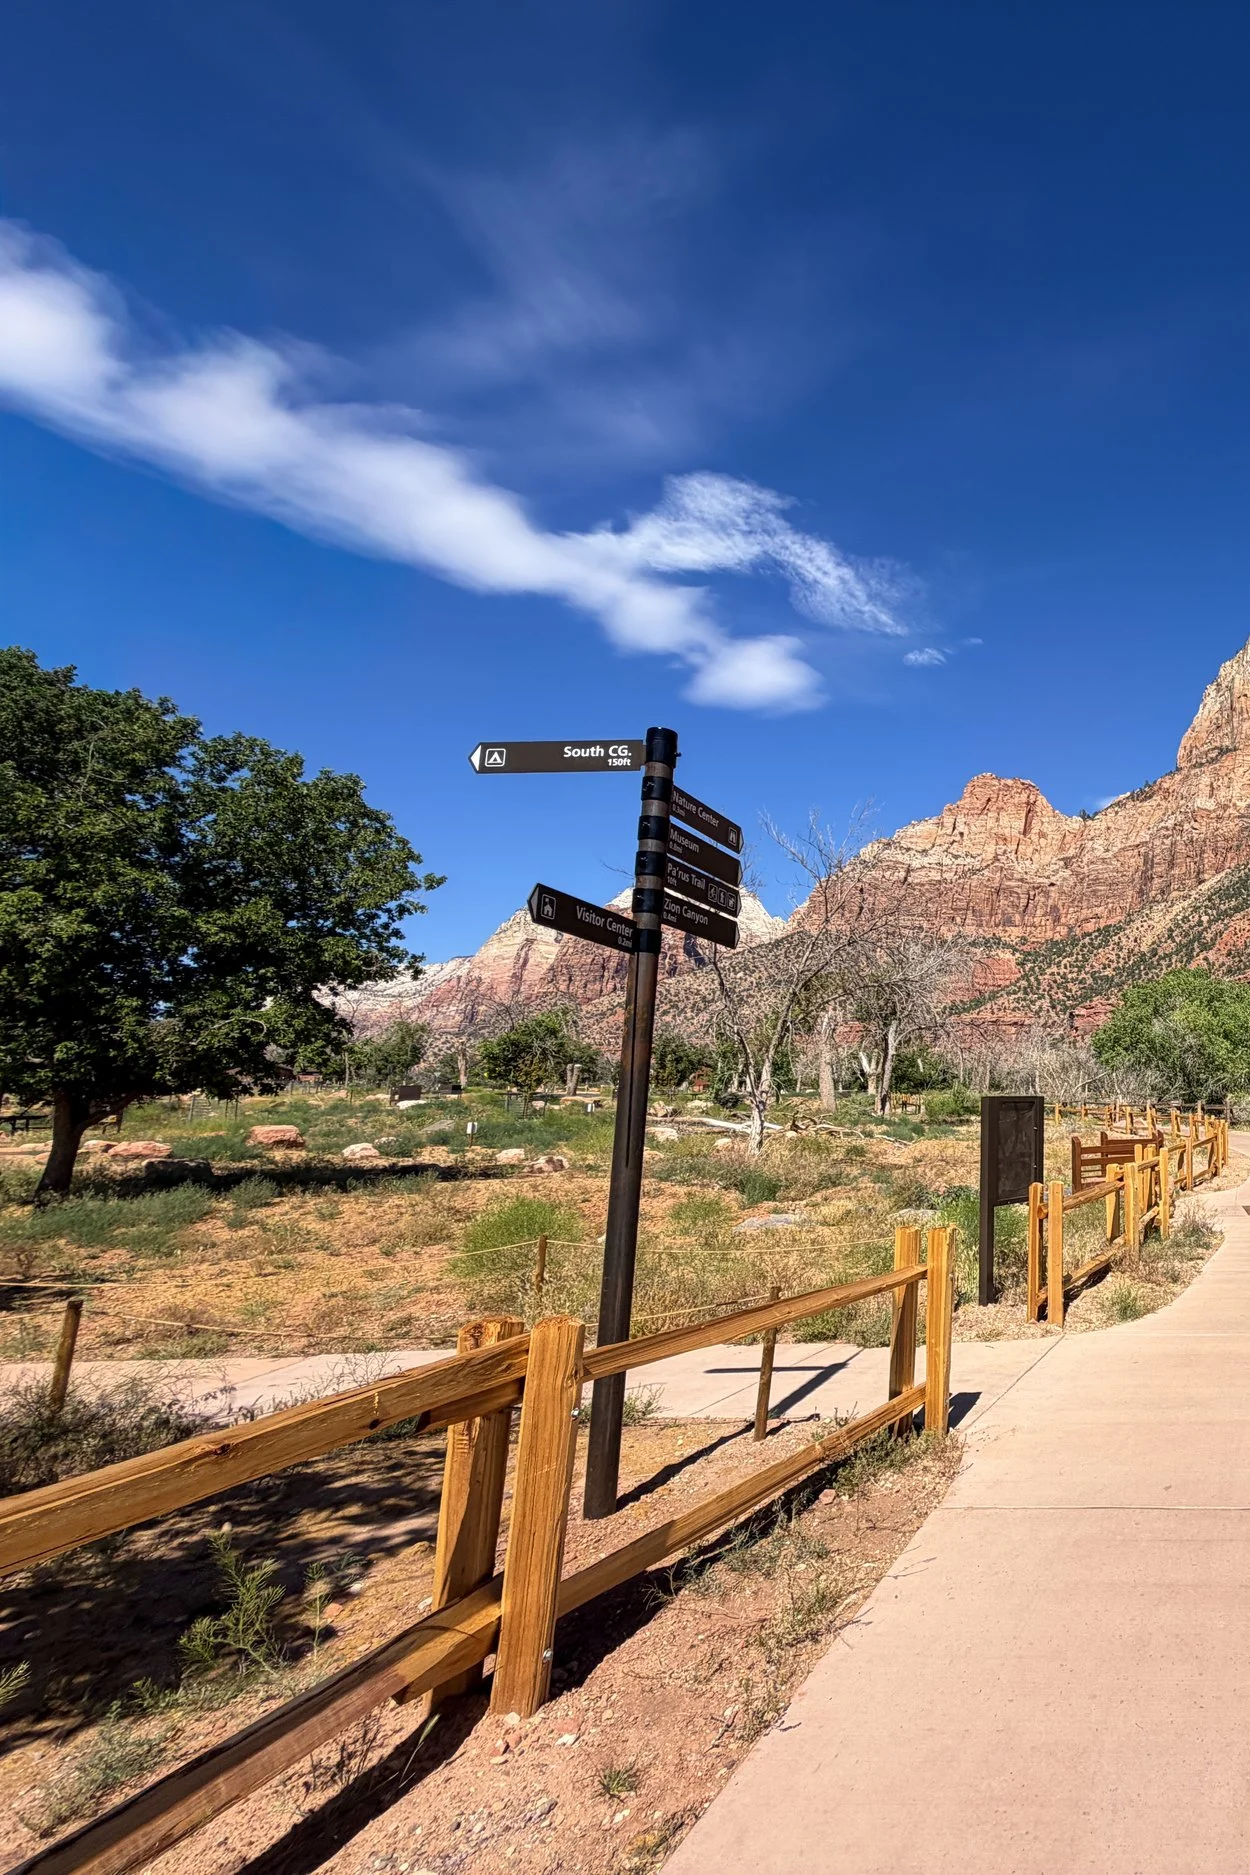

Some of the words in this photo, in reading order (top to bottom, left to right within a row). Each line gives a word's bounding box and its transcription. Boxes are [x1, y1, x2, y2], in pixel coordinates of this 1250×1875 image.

[563, 745, 604, 758] South
[608, 745, 632, 757] CG.
[607, 757, 631, 766] 150ft
[672, 790, 697, 814] Nature
[697, 806, 719, 827] Center
[669, 828, 700, 853] Museum
[667, 862, 689, 882] Pa'rus
[691, 873, 706, 890] Trail
[576, 905, 605, 927] Visitor
[606, 918, 633, 937] Center
[664, 898, 681, 914] Zion
[682, 905, 708, 925] Canyon
[617, 936, 632, 948] 0.2mi
